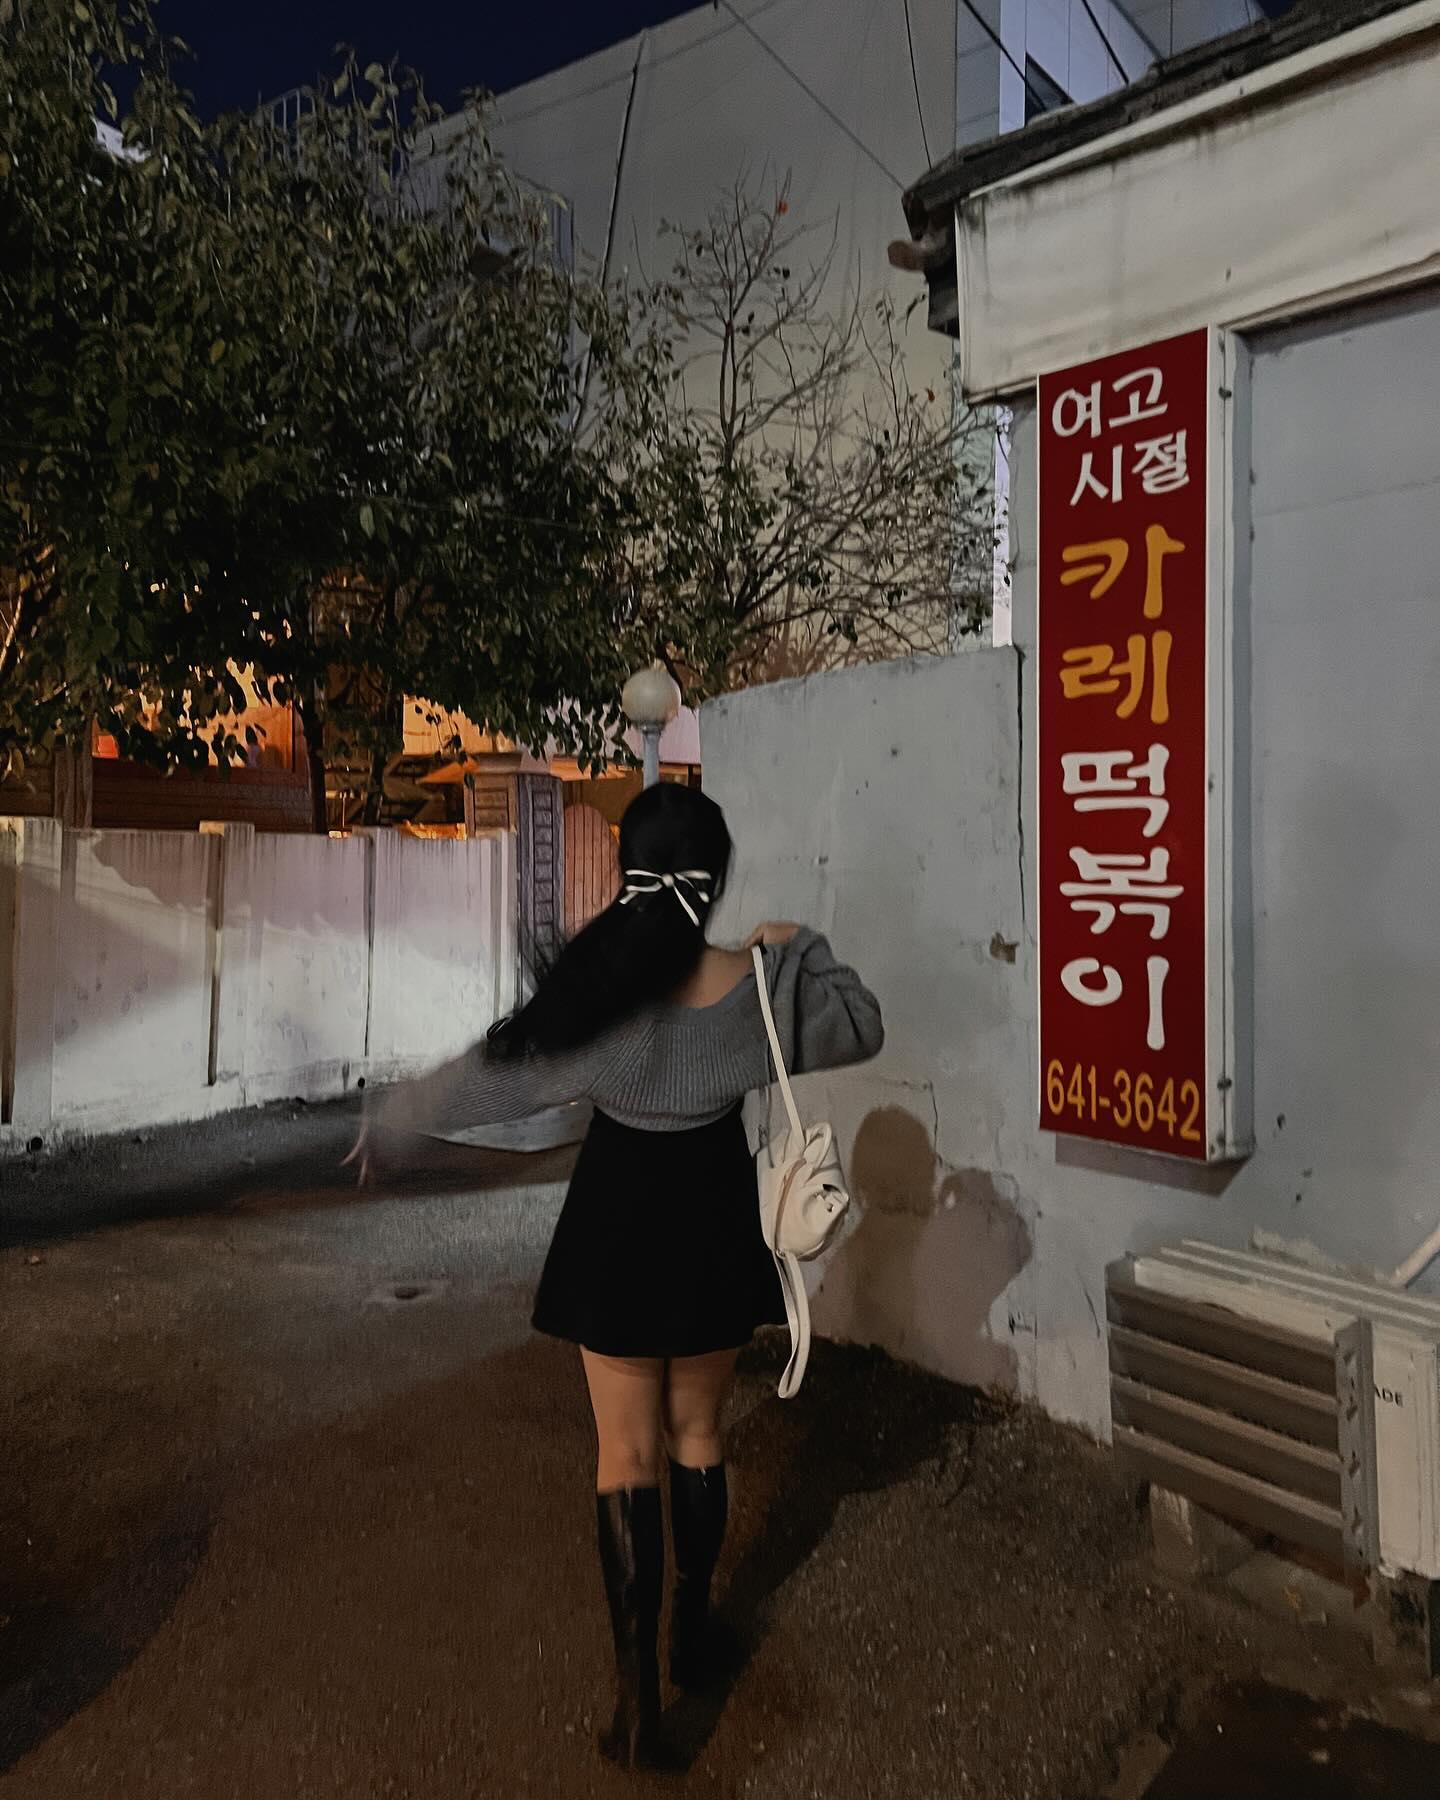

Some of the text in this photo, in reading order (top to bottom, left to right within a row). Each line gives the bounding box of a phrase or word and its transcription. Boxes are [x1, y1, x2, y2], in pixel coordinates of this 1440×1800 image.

[1052, 367, 1168, 438] 여고
[1070, 429, 1190, 506] 시절
[1046, 1058, 1201, 1141] 641-3642
